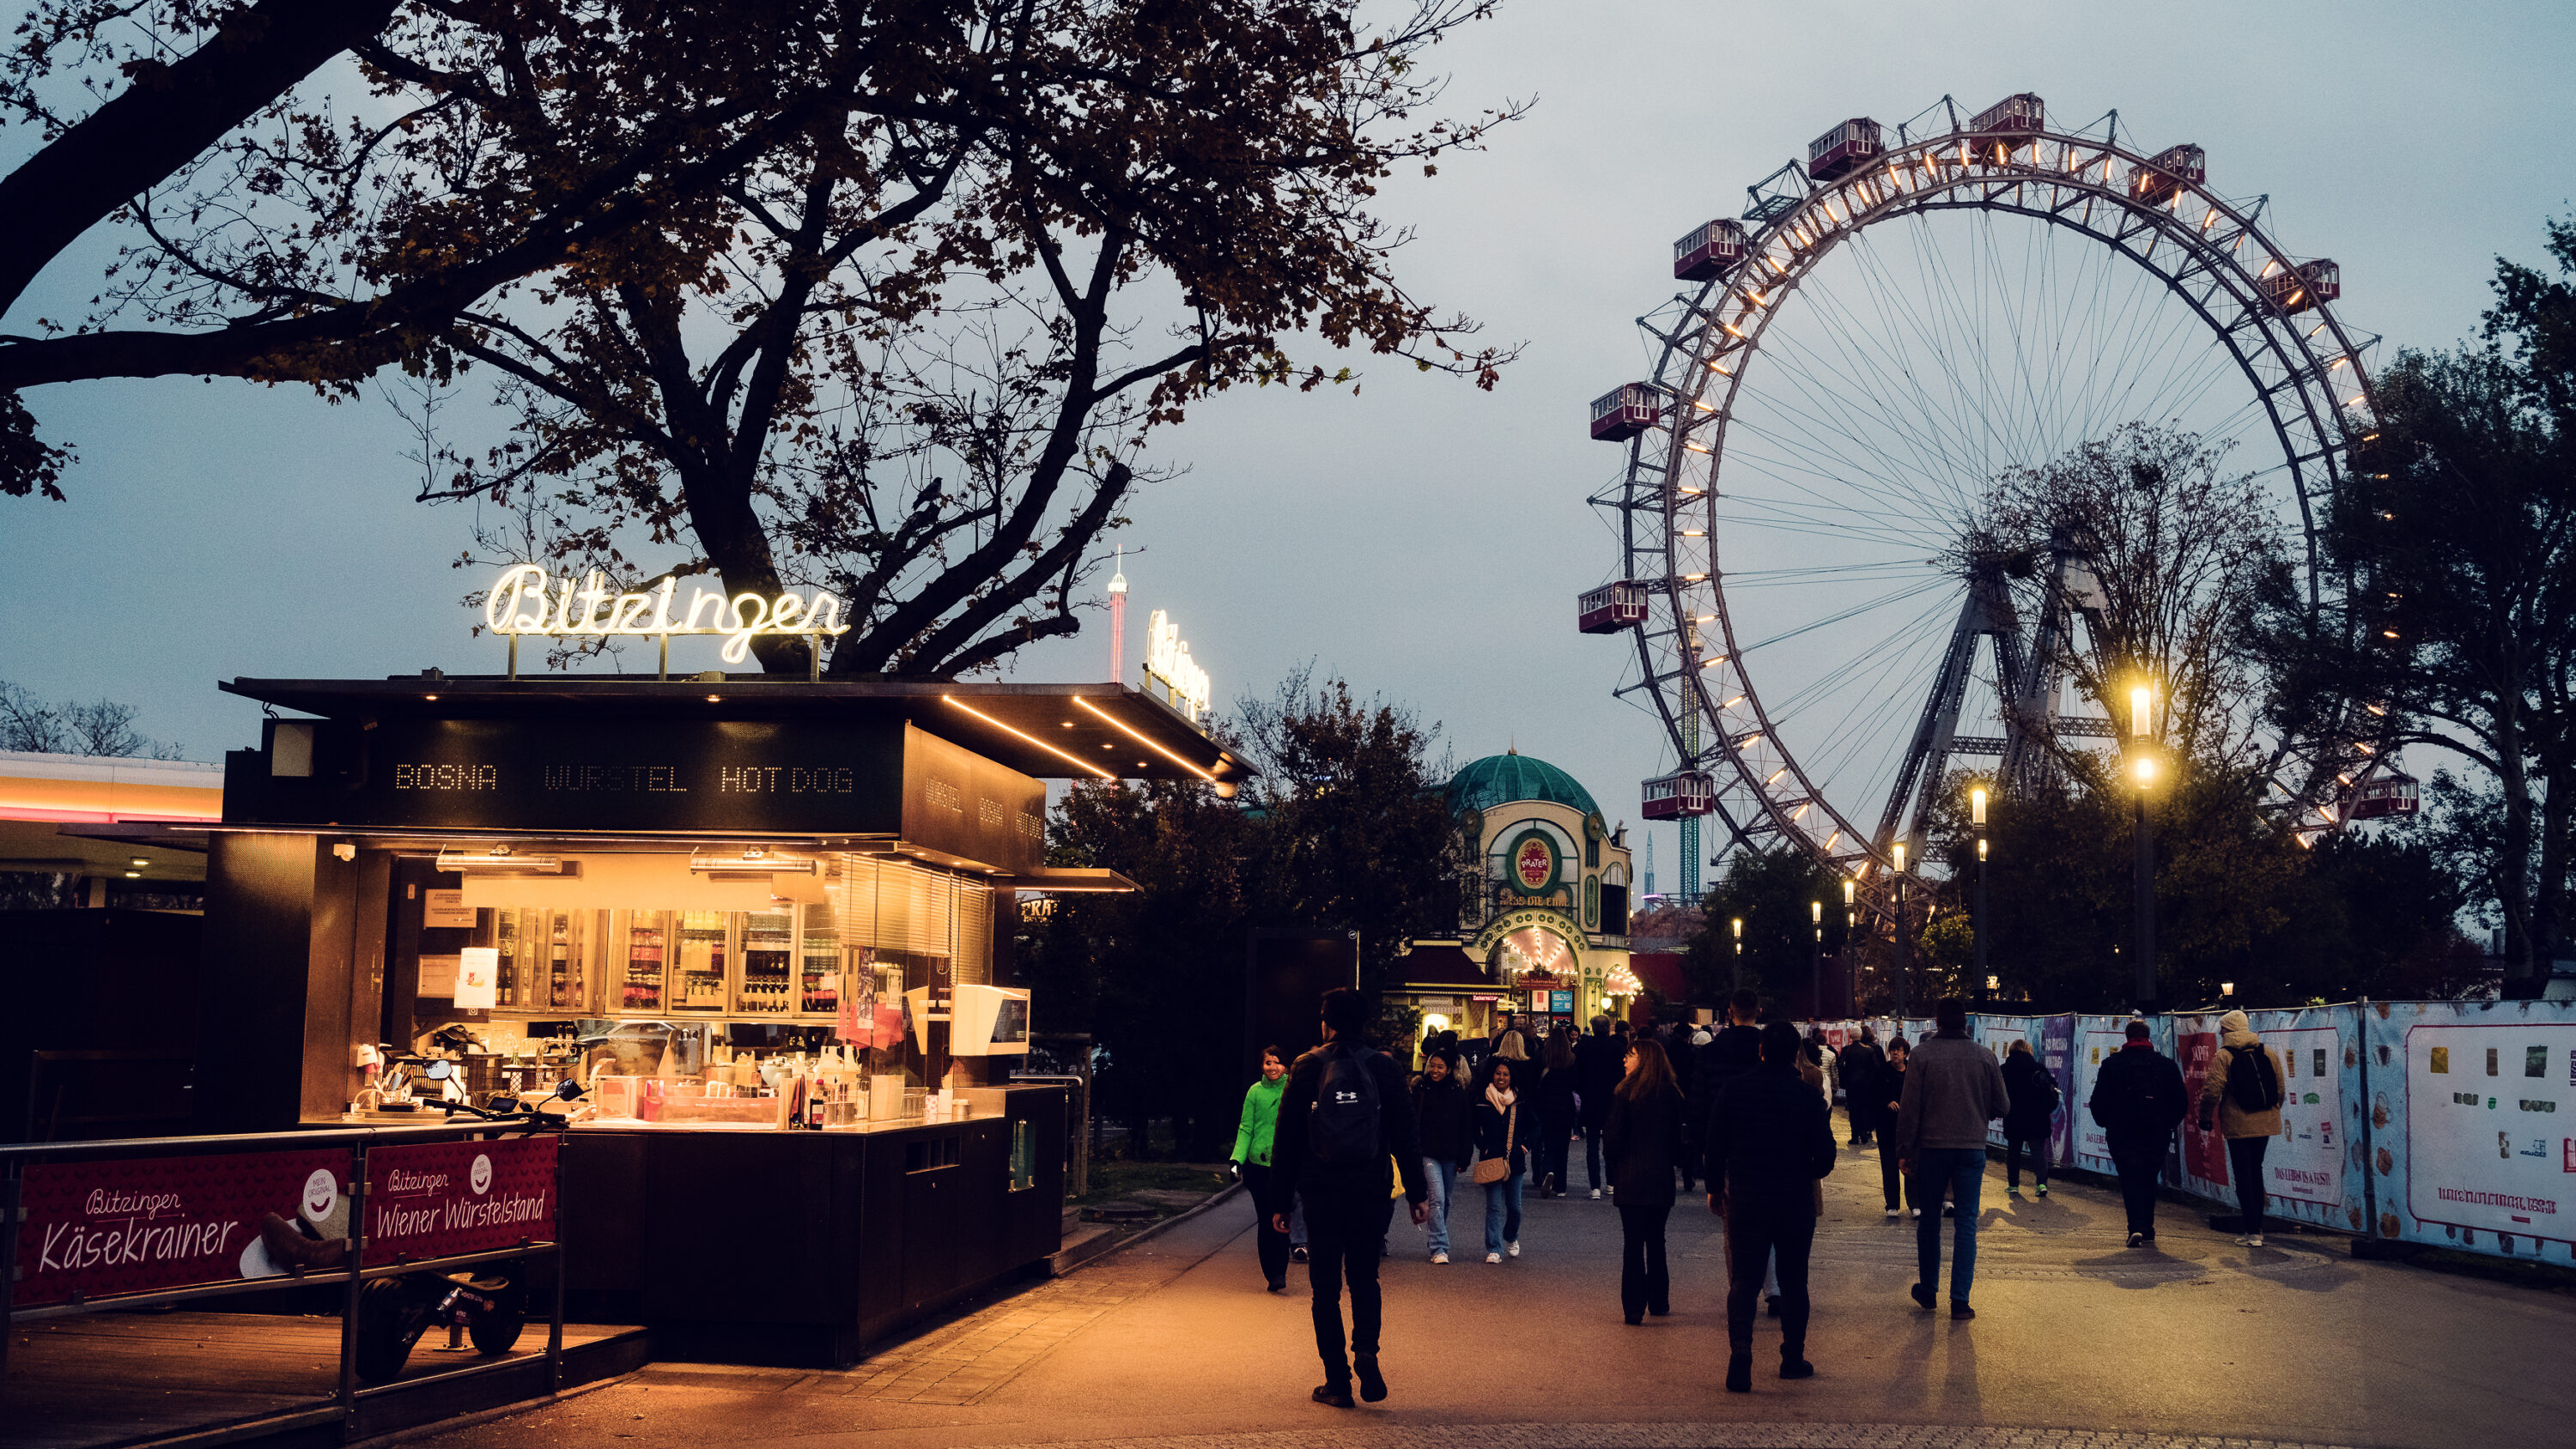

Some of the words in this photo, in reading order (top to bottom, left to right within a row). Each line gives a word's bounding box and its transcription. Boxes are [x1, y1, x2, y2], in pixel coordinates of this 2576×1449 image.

[486, 563, 851, 664] Bitzinger
[396, 764, 496, 790] BOSNA
[721, 767, 782, 792] HOT
[792, 767, 853, 793] DOG
[1521, 858, 1547, 868] PRATER
[308, 1185, 331, 1197] ORIGINAL
[313, 1177, 326, 1187] MEIN
[388, 1168, 449, 1197] Bitzinger
[86, 1188, 181, 1220] Bitzinger
[378, 1203, 440, 1239] Wiener
[446, 1188, 545, 1230] Würstelstand
[39, 1213, 239, 1272] Käsekrainer
